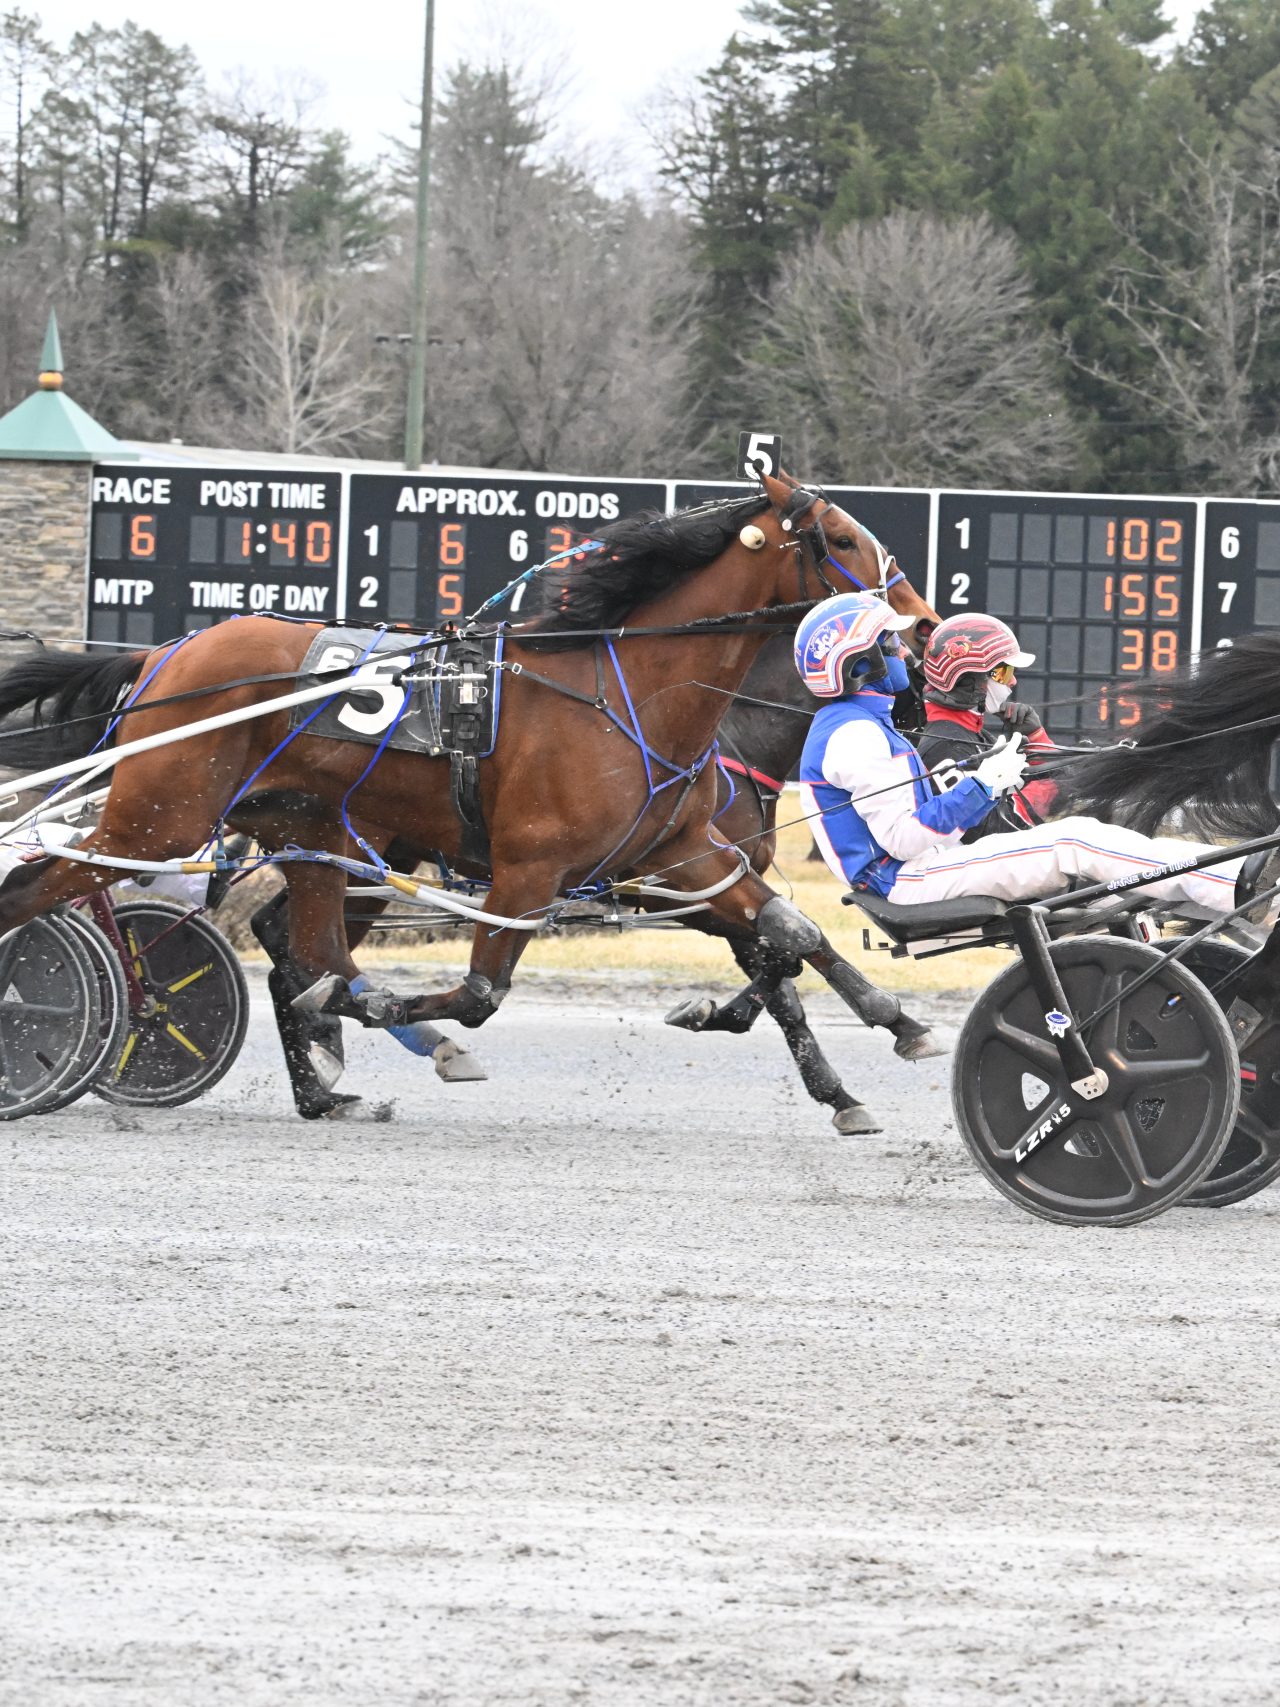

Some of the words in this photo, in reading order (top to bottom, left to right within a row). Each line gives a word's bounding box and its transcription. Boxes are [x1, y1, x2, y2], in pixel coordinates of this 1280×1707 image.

[744, 433, 775, 481] 5
[92, 477, 172, 505] RACE
[200, 480, 263, 508] POST
[267, 482, 326, 510] TIME
[396, 487, 526, 516] APPROX.
[535, 491, 620, 520] ODDS
[131, 515, 155, 556] 6
[242, 521, 332, 563] 1:40
[363, 524, 379, 556] 1
[440, 523, 465, 565] 6
[508, 529, 529, 562] 6
[955, 517, 971, 550] 1
[1106, 519, 1182, 562] 102
[1220, 526, 1240, 559] 6
[94, 578, 154, 605] MTP
[189, 581, 245, 609] TIME
[249, 583, 280, 610] OF
[284, 585, 329, 612] DAY
[358, 576, 379, 608] 2
[438, 574, 463, 616] 5
[950, 572, 971, 605] 2
[1104, 574, 1179, 617] 155
[1217, 581, 1238, 614] 7
[1121, 628, 1178, 672] 38
[337, 652, 415, 735] 5
[1014, 1119, 1054, 1163] LZR
